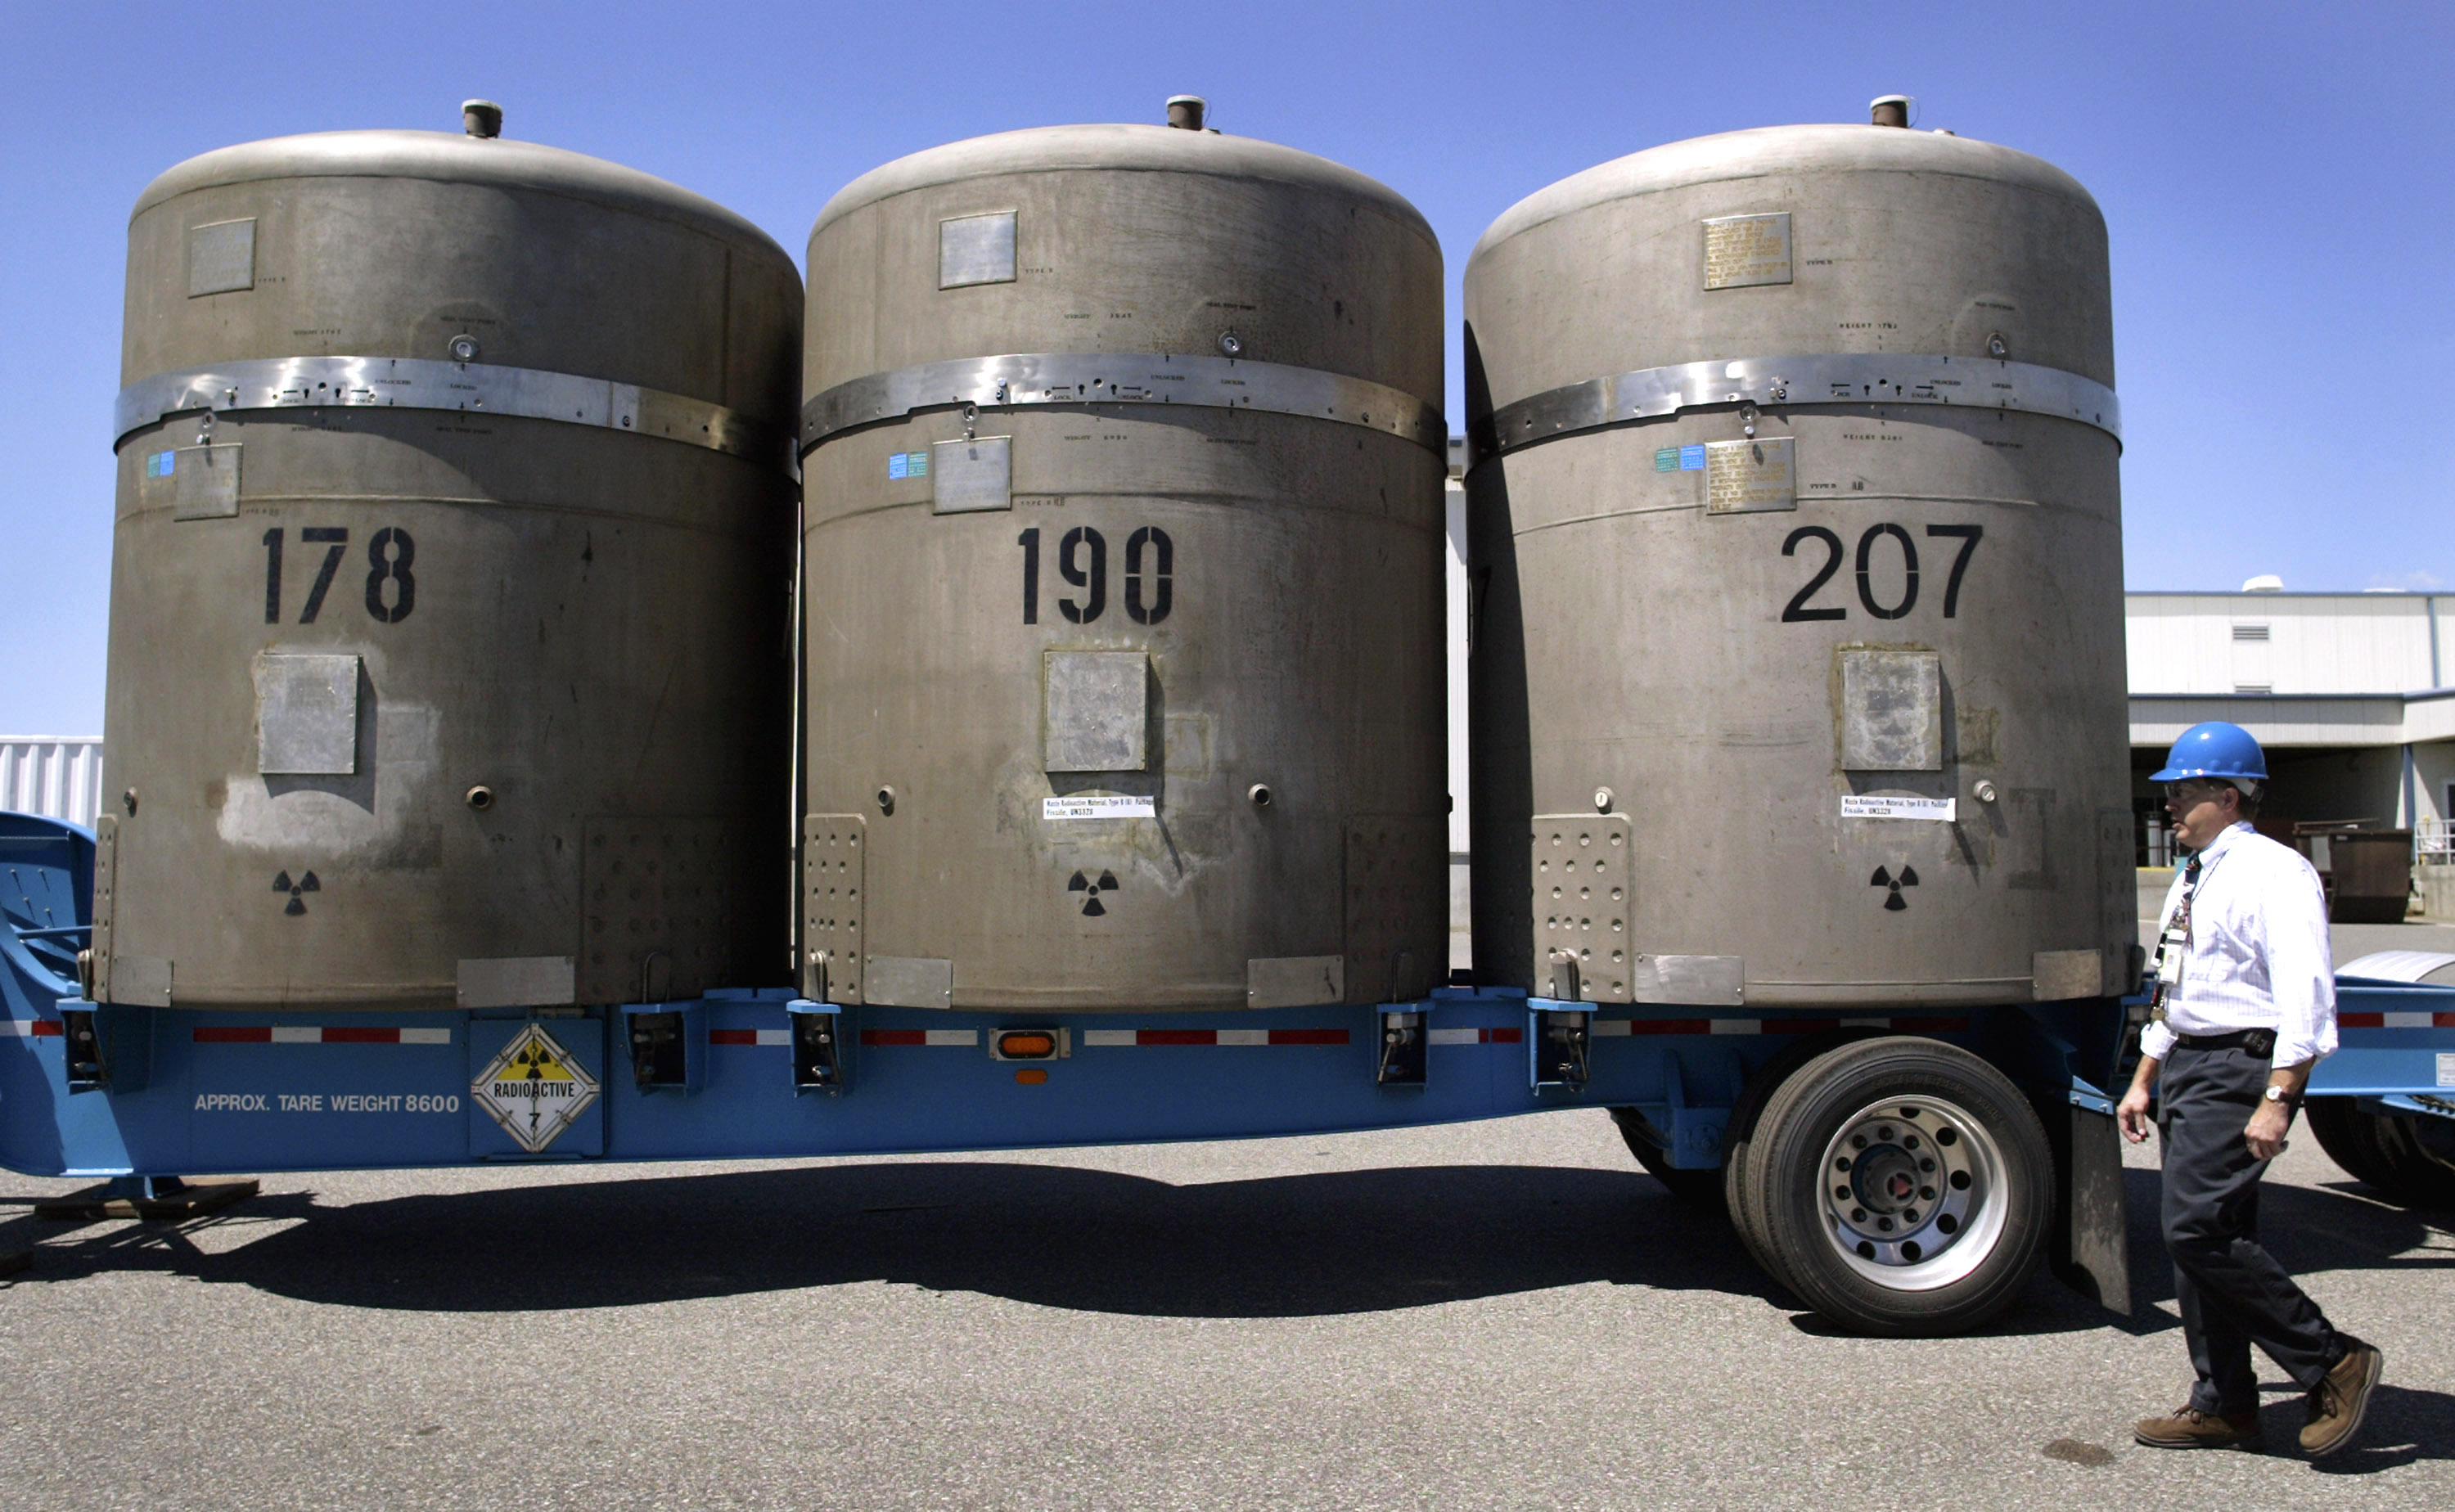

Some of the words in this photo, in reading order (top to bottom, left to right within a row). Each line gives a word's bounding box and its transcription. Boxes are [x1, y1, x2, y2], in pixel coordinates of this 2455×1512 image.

[263, 526, 416, 624] 178
[1018, 525, 1173, 625] 190
[1782, 522, 1984, 623] 207
[195, 1095, 270, 1111] APPROX.
[278, 1095, 323, 1112] TARE
[331, 1095, 403, 1112] WEIGHT
[405, 1095, 460, 1113] 8600
[494, 1082, 575, 1098] RADIOACTIVE
[528, 1112, 542, 1130] 7
